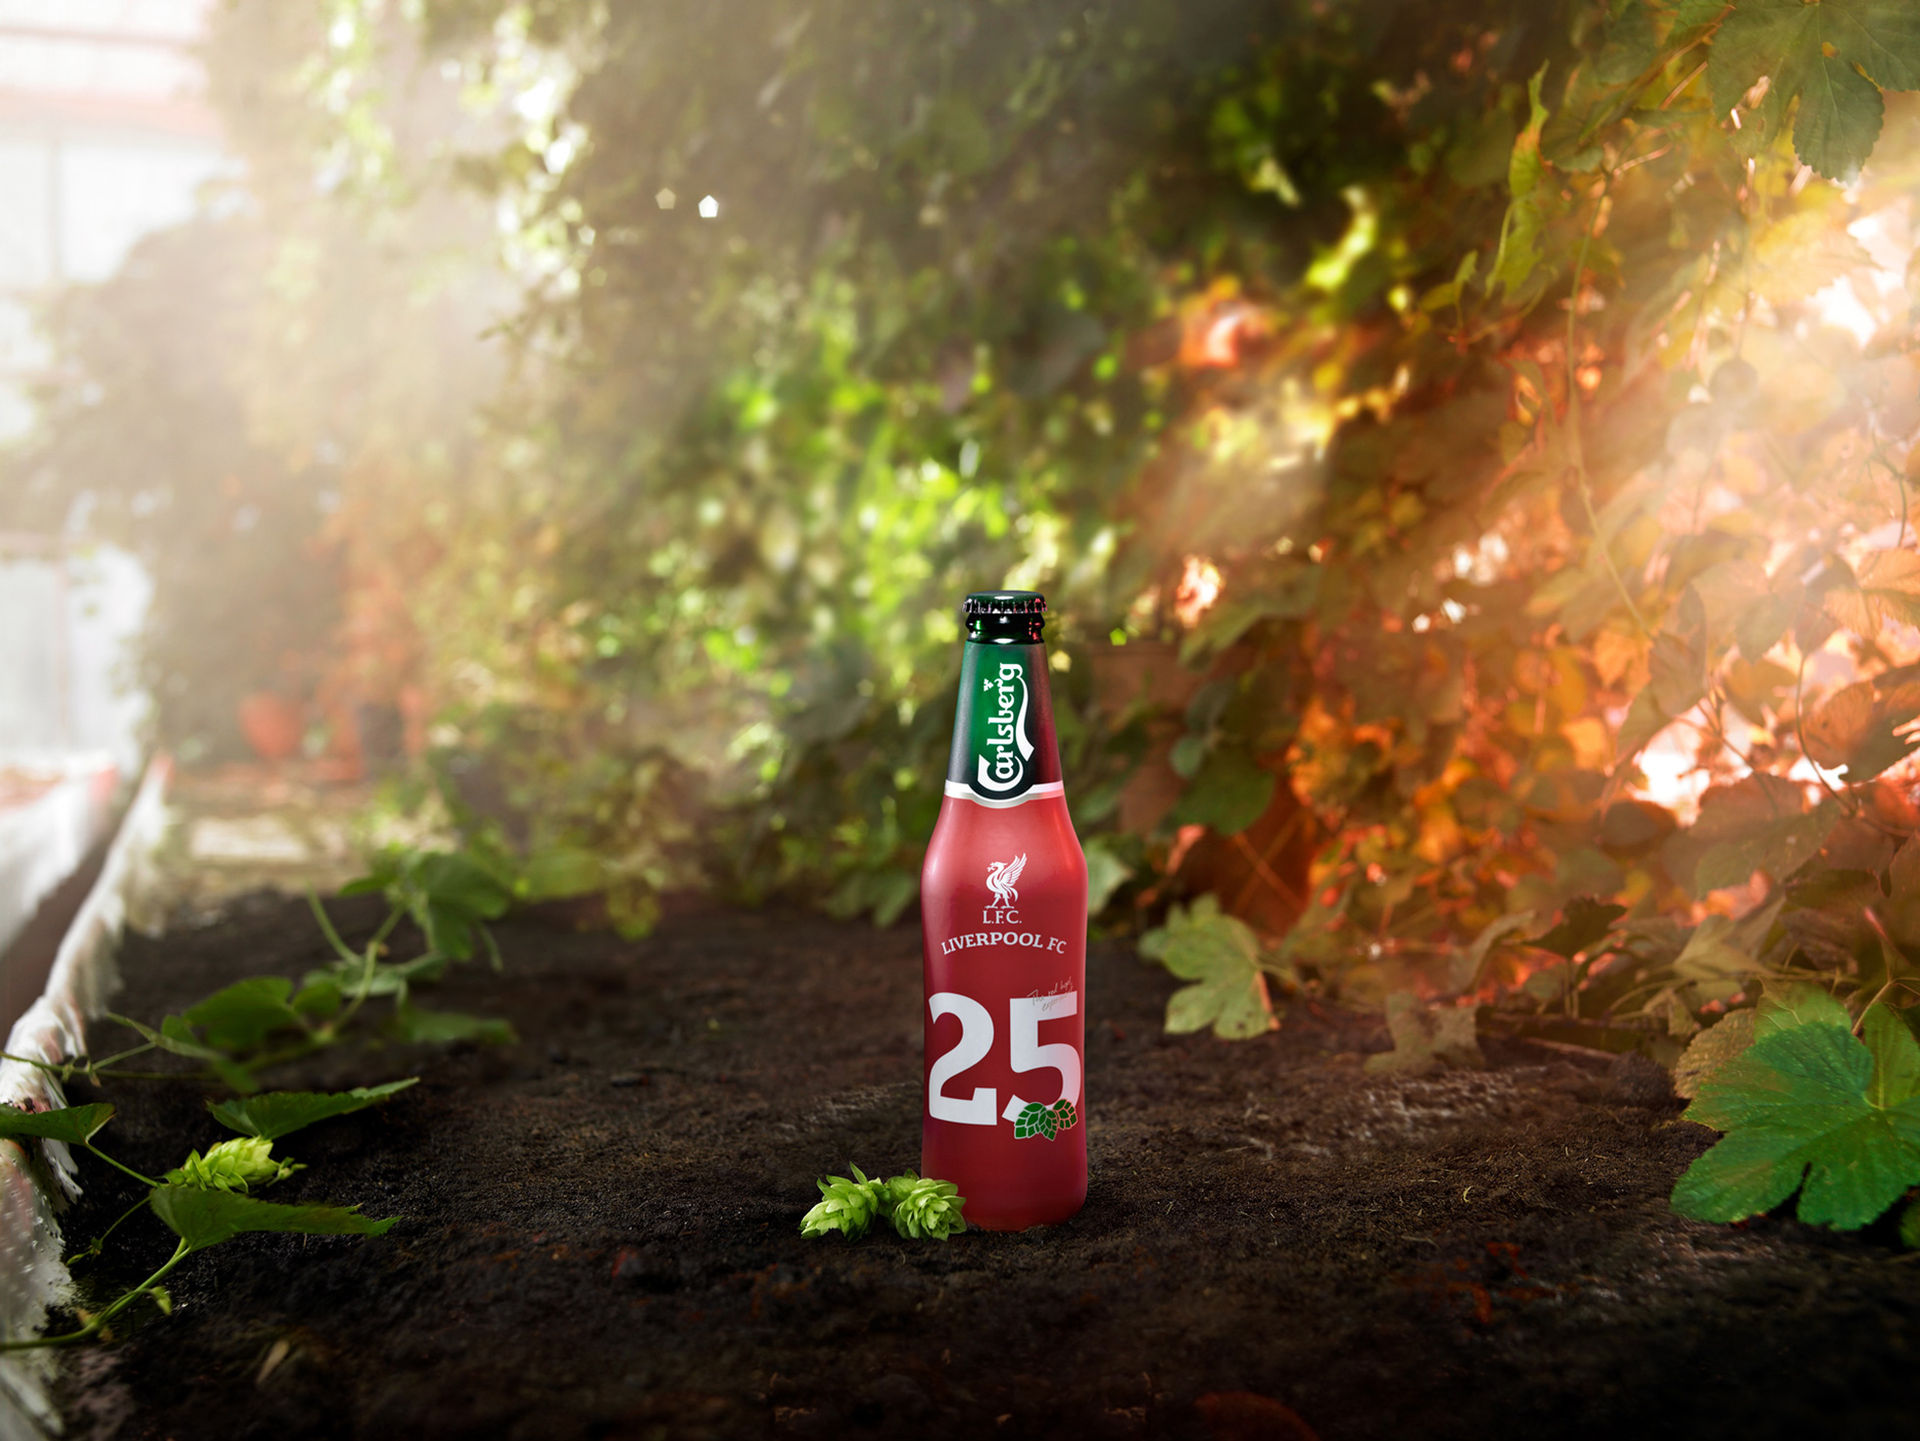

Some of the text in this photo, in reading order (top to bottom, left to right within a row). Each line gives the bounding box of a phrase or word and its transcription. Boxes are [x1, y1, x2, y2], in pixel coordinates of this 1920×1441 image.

[977, 662, 1035, 792] Carlsberg
[941, 931, 1067, 955] LIVERPOOL FC
[982, 910, 1022, 924] L.F.C.
[928, 990, 1081, 1126] 25
